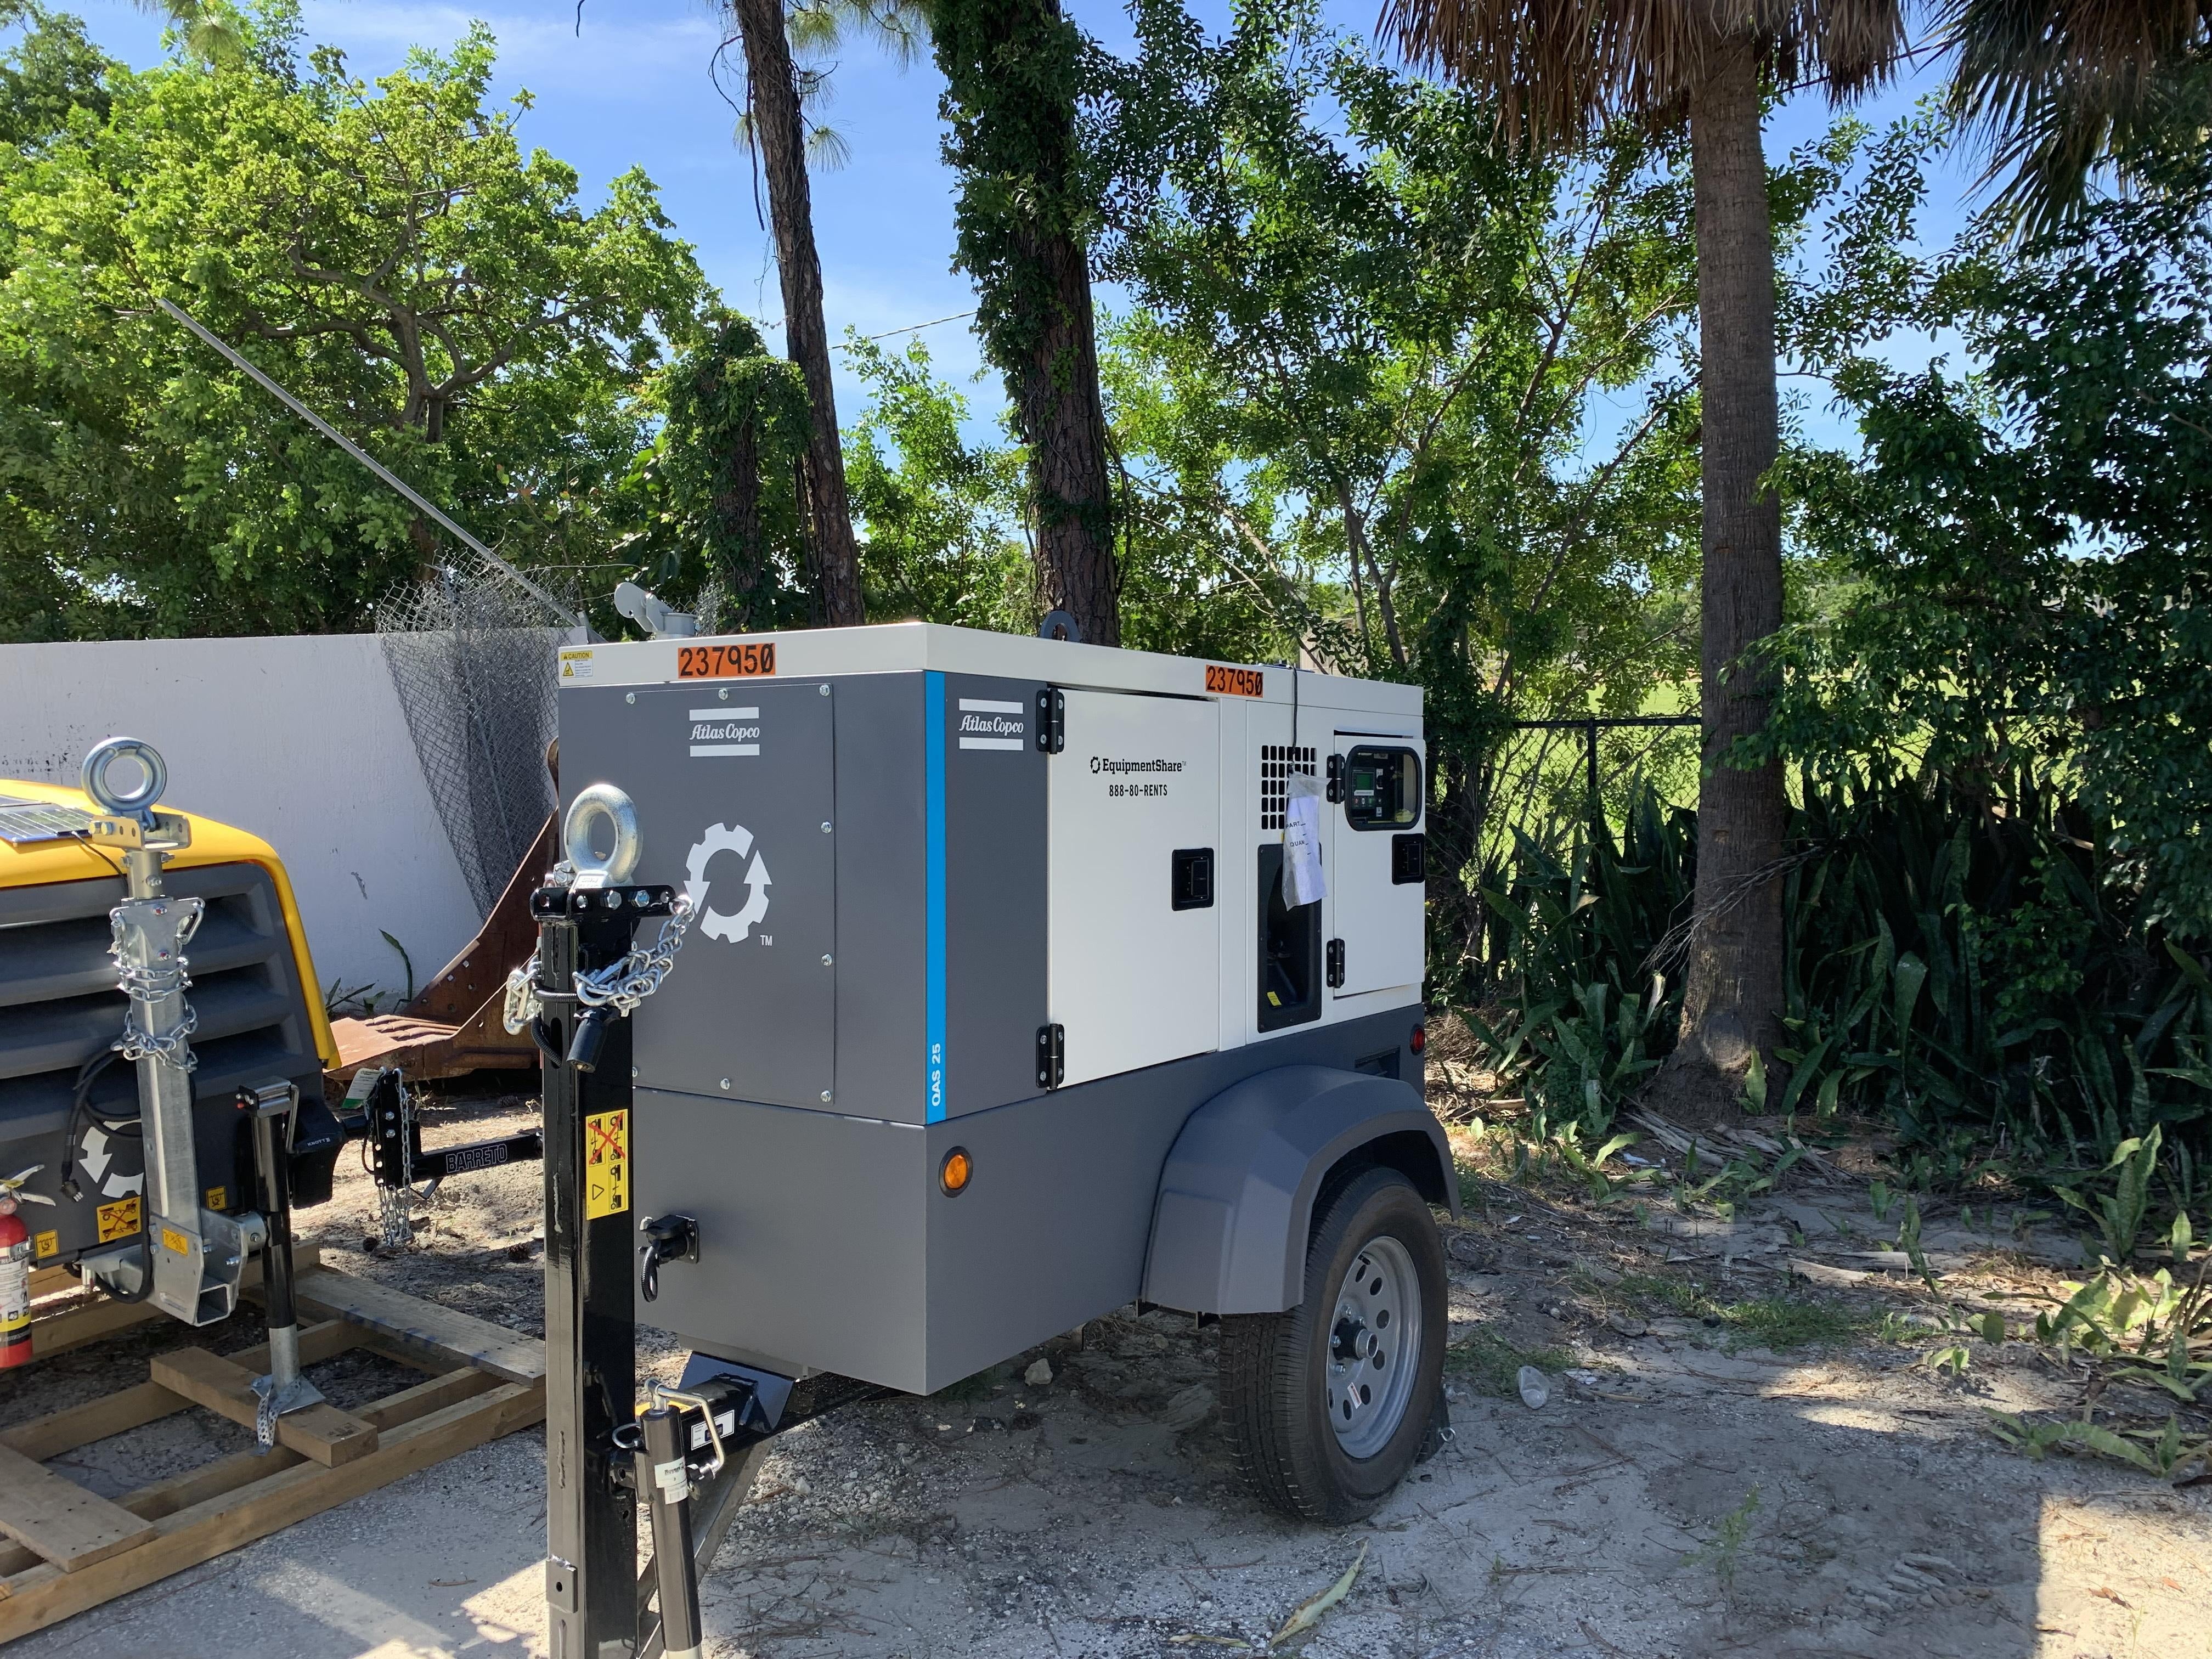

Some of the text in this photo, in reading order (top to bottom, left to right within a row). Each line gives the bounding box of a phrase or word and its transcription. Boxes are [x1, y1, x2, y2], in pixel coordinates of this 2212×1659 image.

[680, 643, 774, 676] 237950
[1207, 665, 1263, 696] 237950
[689, 723, 760, 742] Atlas Copco
[959, 715, 1024, 736] Atlas Copco
[1102, 758, 1182, 775] EquipmentShare
[1109, 784, 1168, 797] 888-80-RENTS
[760, 934, 772, 946] TM
[932, 1043, 941, 1106] QAS 25
[446, 1144, 507, 1173] BARRETO
